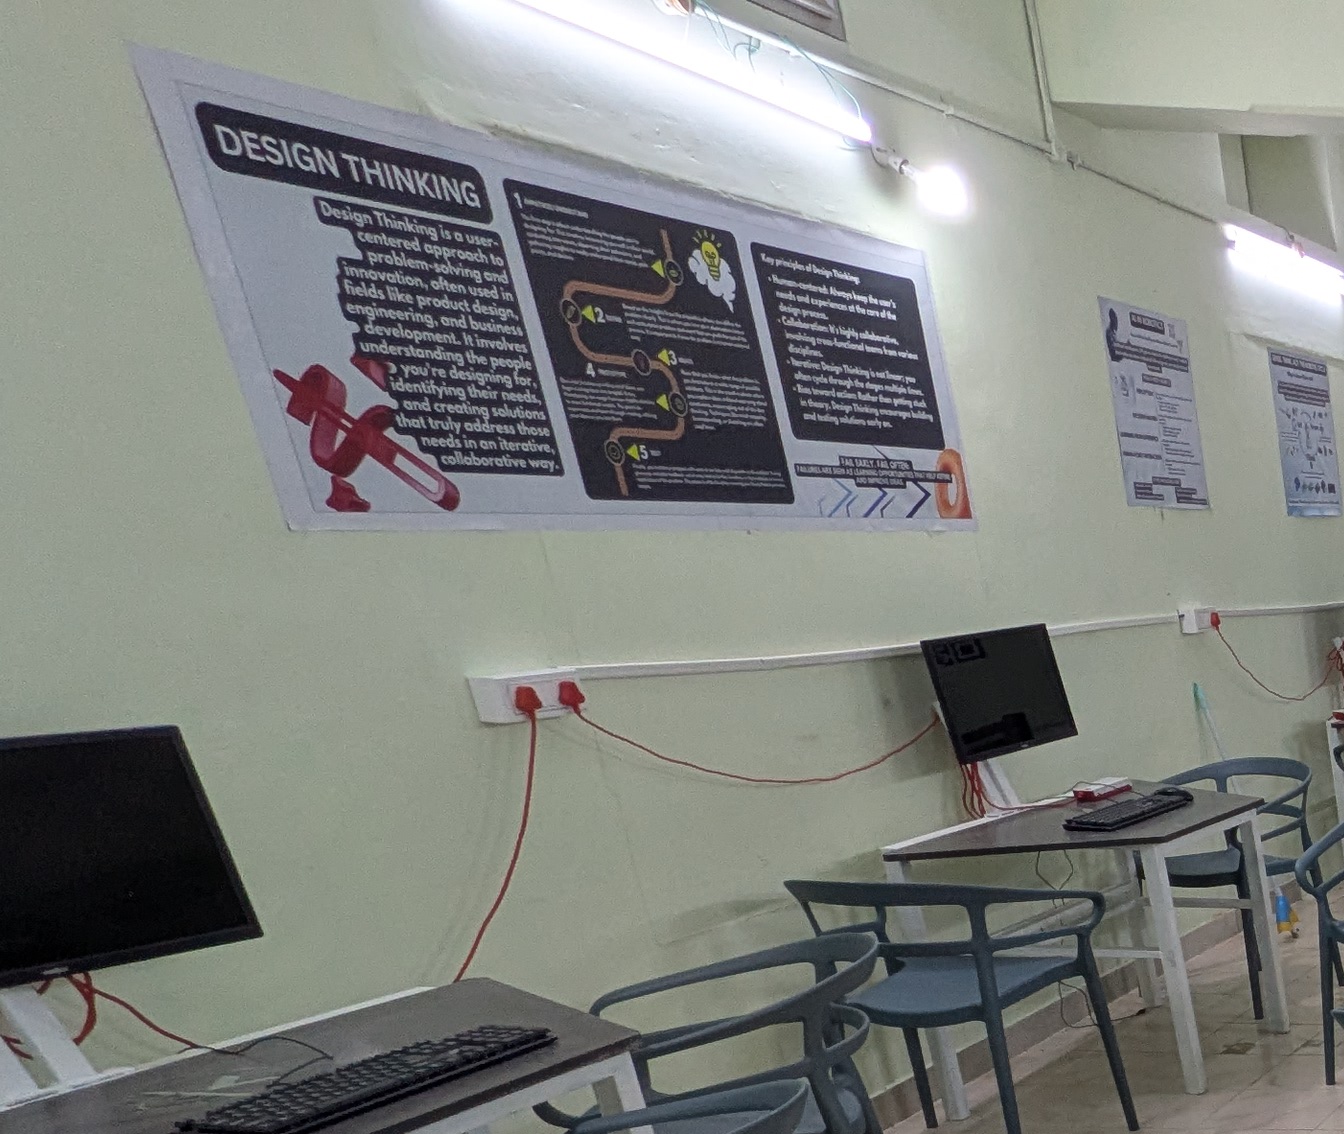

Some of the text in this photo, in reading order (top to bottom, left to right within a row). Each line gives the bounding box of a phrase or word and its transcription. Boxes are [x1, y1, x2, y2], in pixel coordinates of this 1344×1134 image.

[213, 123, 482, 208] DESIGN THINKING
[514, 192, 522, 209] 1
[320, 201, 498, 248] Design Thinking is a user-
[357, 230, 504, 266] centered approach to
[368, 251, 509, 285] problem-solving and
[342, 261, 514, 302] innovation, often used in
[343, 279, 519, 322] fields like product design,
[346, 303, 523, 337] engineering, and business
[594, 308, 606, 323] 2
[364, 322, 528, 354] development. It involves
[360, 339, 532, 371] understanding the people
[669, 350, 678, 365] 3
[401, 363, 538, 389] you're designing for,
[586, 363, 596, 378] 4
[389, 379, 542, 406] identifying their needs,
[403, 398, 546, 421] and creating solutions
[395, 413, 550, 436] that truly address those
[420, 434, 555, 454] needs in an iterative,
[639, 445, 649, 460] 5
[441, 451, 560, 473] collaborative way.
